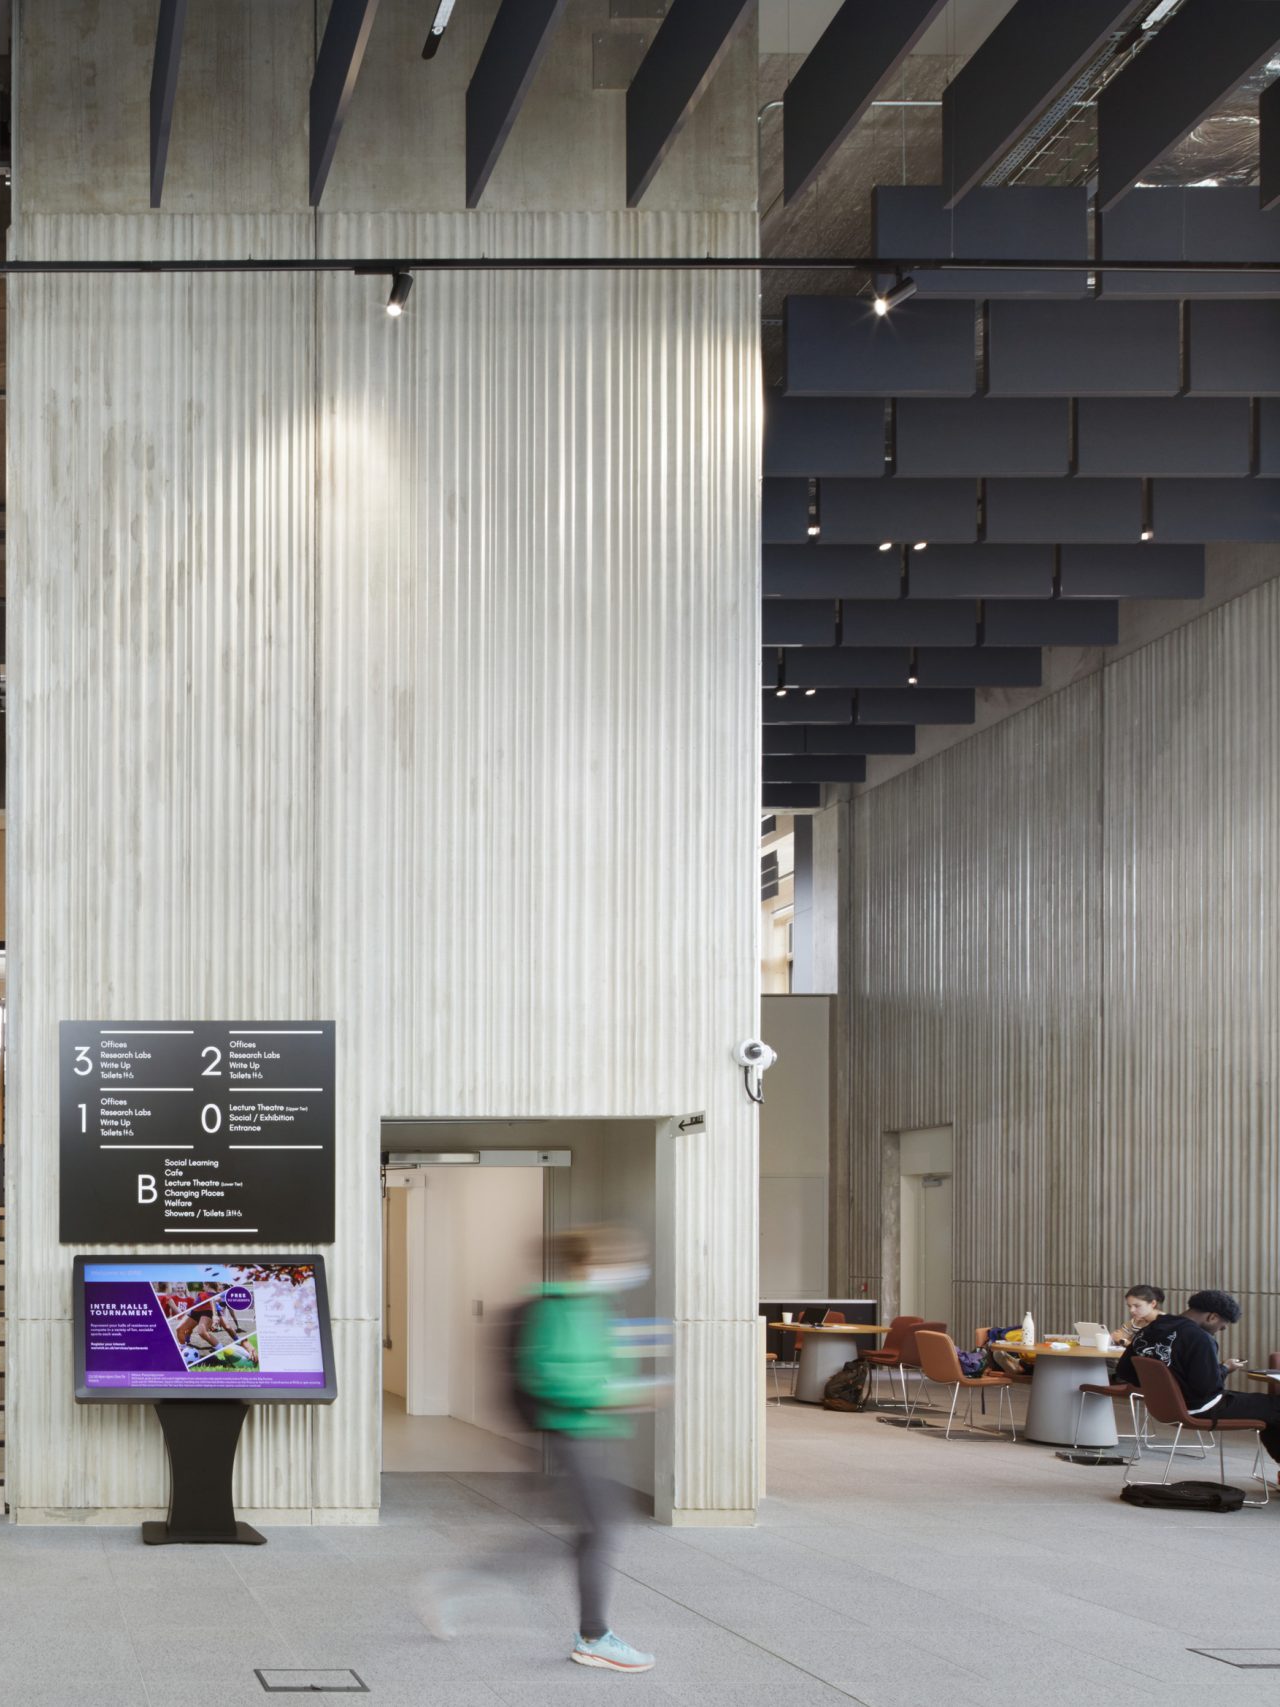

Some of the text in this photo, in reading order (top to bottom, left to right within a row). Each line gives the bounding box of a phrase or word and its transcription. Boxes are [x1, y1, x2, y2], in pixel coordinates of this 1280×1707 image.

[100, 1040, 127, 1049] Offices
[229, 1040, 256, 1049] Offices
[100, 1051, 152, 1059] Research Labs
[229, 1051, 280, 1059] Research Labs
[73, 1046, 93, 1076] 3
[100, 1061, 131, 1070] Write Up
[201, 1046, 222, 1076] 2
[229, 1061, 260, 1070] Write Up
[100, 1071, 122, 1079] Toilets
[229, 1071, 251, 1079] Toilets
[100, 1097, 127, 1106] Offices
[100, 1108, 152, 1116] Research Labs
[229, 1104, 256, 1112] Lecture
[258, 1103, 285, 1112] Theatre
[78, 1103, 86, 1133] 1
[201, 1103, 222, 1134] 0
[229, 1114, 252, 1122] Social
[260, 1114, 294, 1122] Exhibition
[100, 1119, 131, 1128] Write Up
[229, 1124, 261, 1132] Entrance
[100, 1128, 122, 1136] Toilets
[164, 1159, 219, 1168] Social Learning
[164, 1169, 183, 1177] Cafe
[164, 1179, 191, 1187] Lecture
[193, 1179, 220, 1187] Theatre
[138, 1174, 158, 1204] B
[164, 1189, 224, 1198] Changing Places
[164, 1199, 192, 1207] Welfare
[164, 1209, 195, 1217] Showers
[203, 1209, 224, 1217] Toilets
